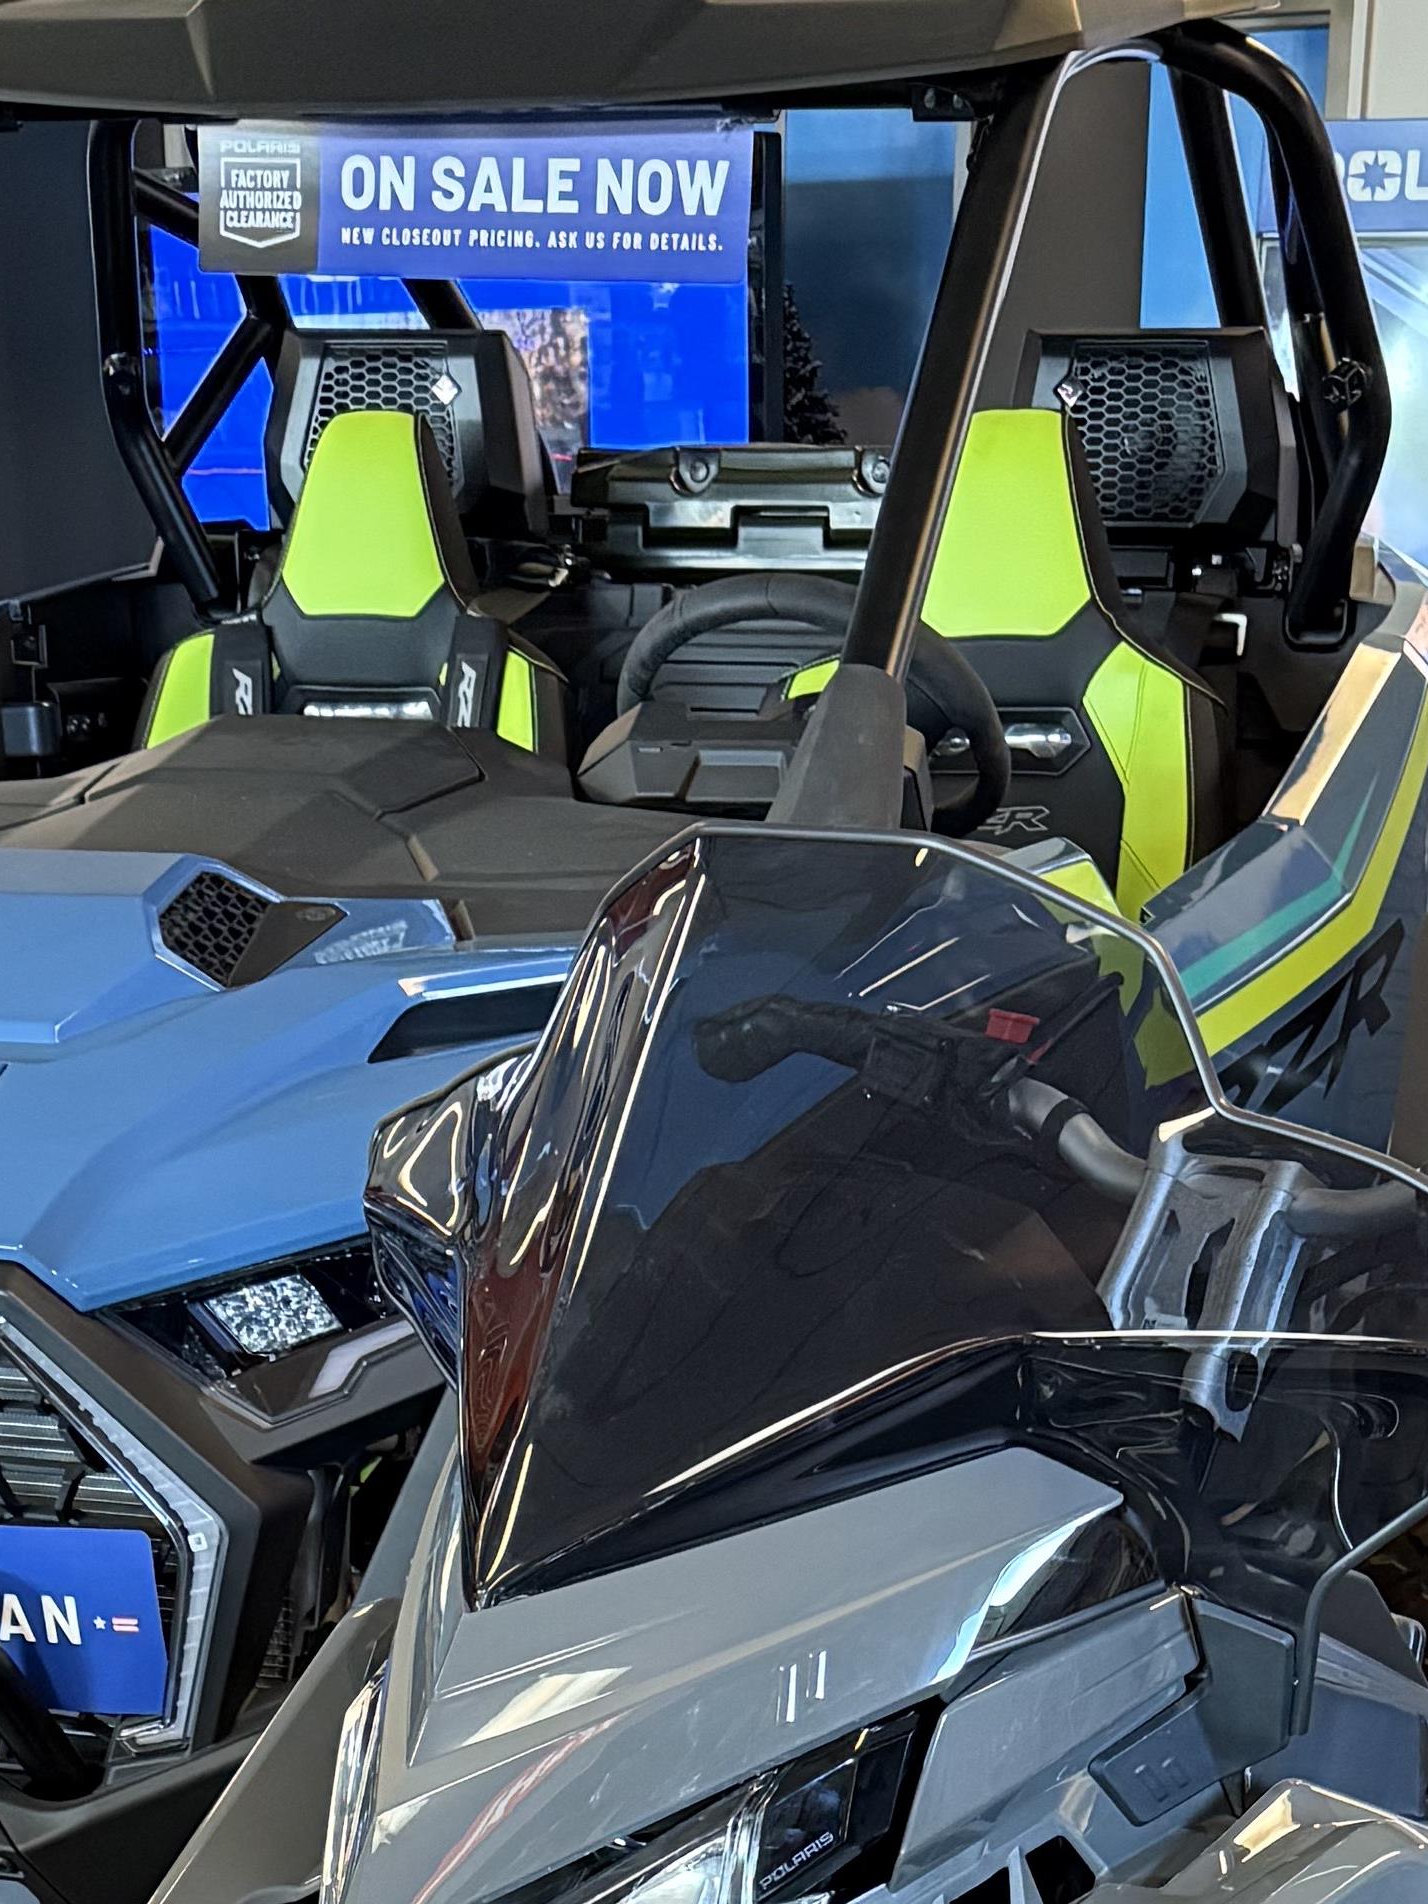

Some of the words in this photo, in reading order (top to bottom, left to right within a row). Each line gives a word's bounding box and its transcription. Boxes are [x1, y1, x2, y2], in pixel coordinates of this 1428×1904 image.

[219, 139, 301, 154] POLARIS
[230, 168, 290, 188] FACTORY
[341, 154, 415, 211] ON
[431, 155, 581, 214] SALE
[595, 158, 730, 217] NOW
[220, 191, 302, 210] AUTHORIZED
[225, 211, 294, 229] CLEARANCE
[341, 227, 375, 245] NEW
[382, 227, 461, 246] CLOSEOUT
[468, 229, 541, 248] PRICING.
[547, 231, 579, 249] ASK
[585, 232, 605, 249] US
[612, 232, 642, 250] FOR
[649, 232, 723, 251] DETAILS.
[759, 1830, 834, 1893] POLARIS
